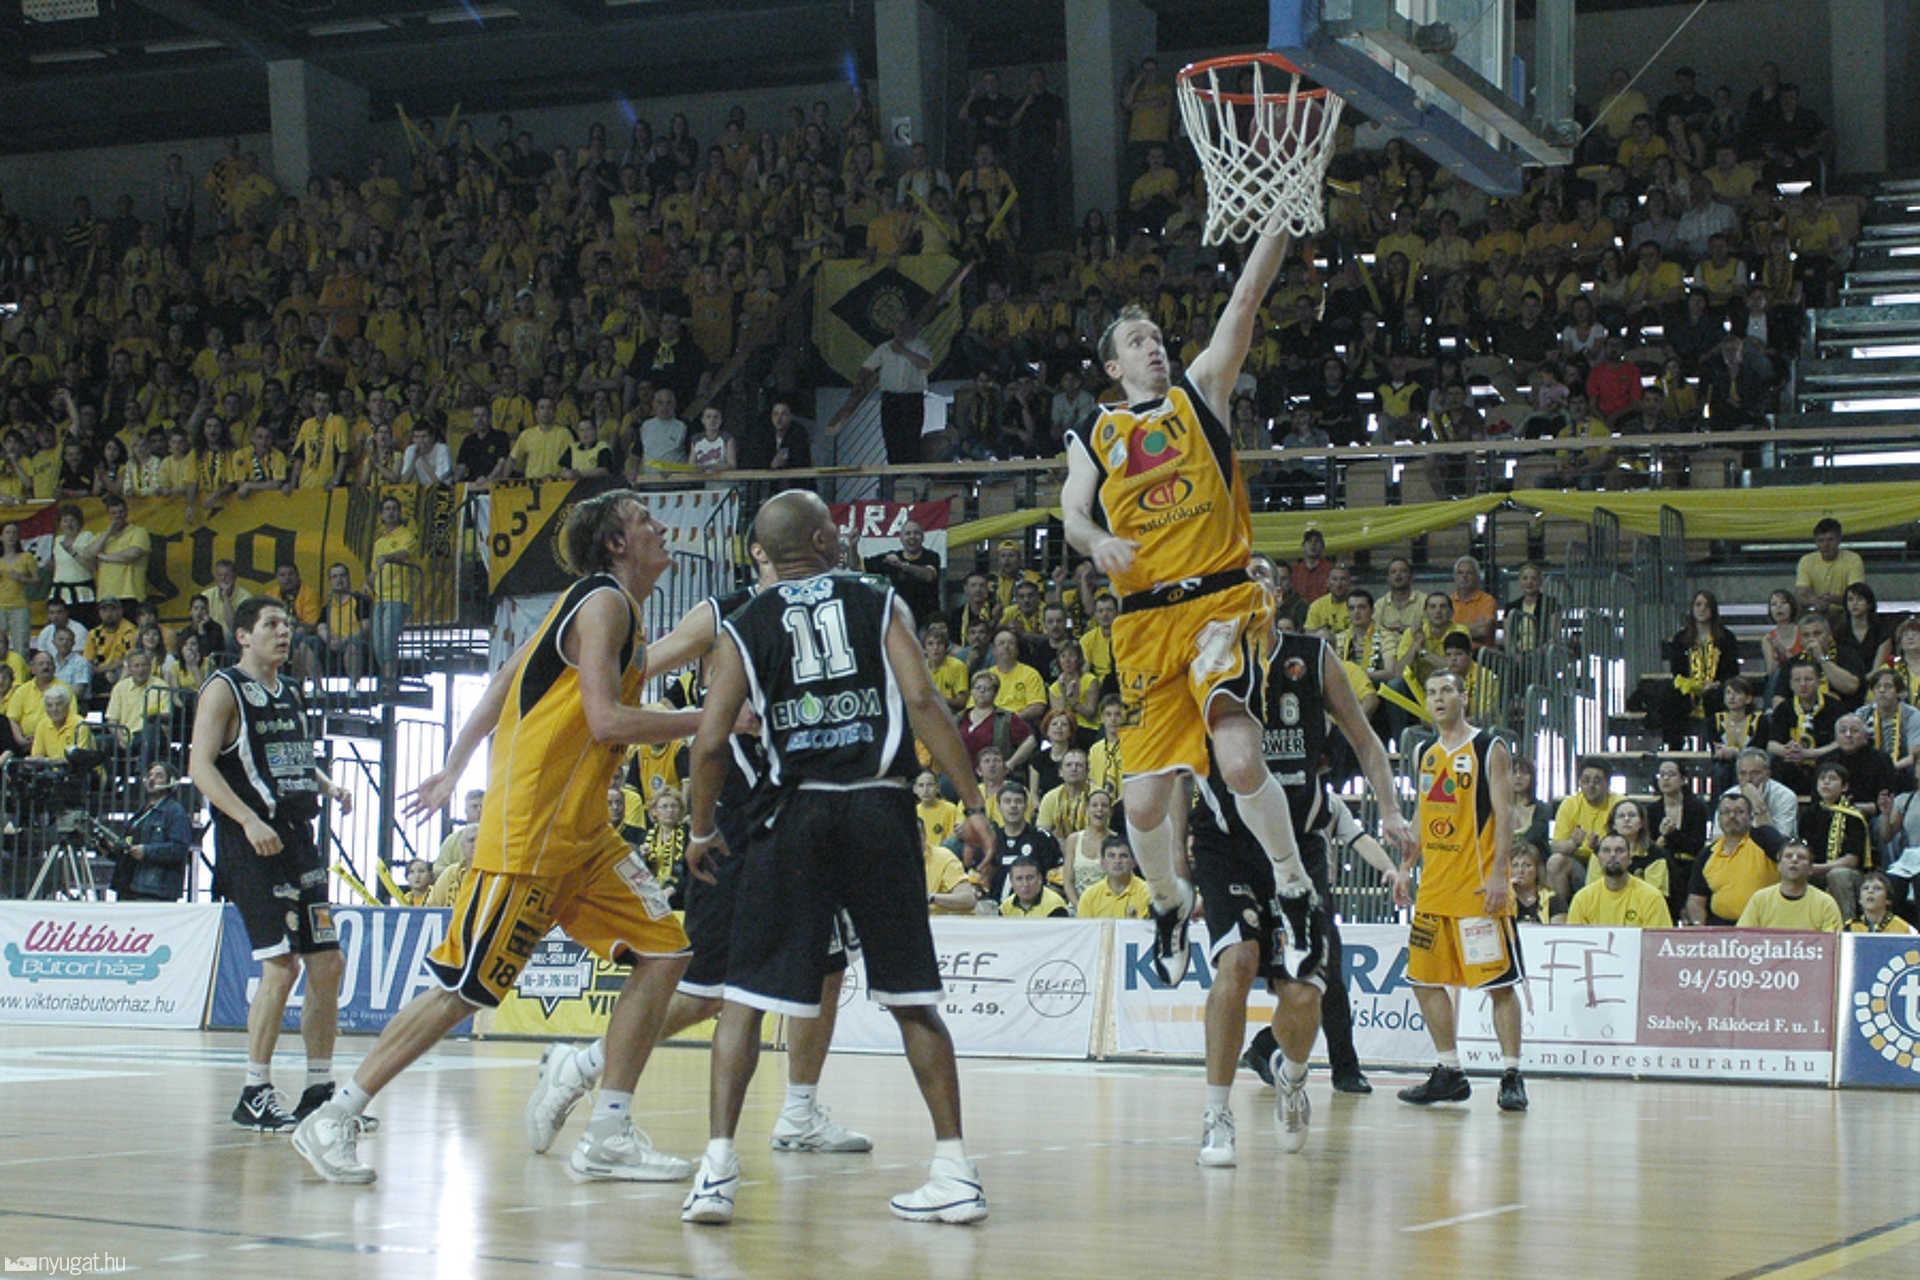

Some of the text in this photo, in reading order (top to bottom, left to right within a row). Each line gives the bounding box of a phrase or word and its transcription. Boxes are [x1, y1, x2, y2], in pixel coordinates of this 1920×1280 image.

[1161, 415, 1187, 440] 11
[781, 599, 858, 684] 11
[1280, 692, 1300, 727] 6
[1456, 771, 1472, 790] 10
[24, 920, 154, 954] Viktória
[1657, 938, 1823, 964] Asztalfoglalás:
[488, 955, 517, 988] 18
[1678, 968, 1799, 993] 94/509-200
[972, 1003, 1005, 1014] 49.
[1647, 1015, 1825, 1034] Szhely, Rákóczi F. u. 1.
[1467, 1050, 1815, 1072] ww.molorestaurant.hu
